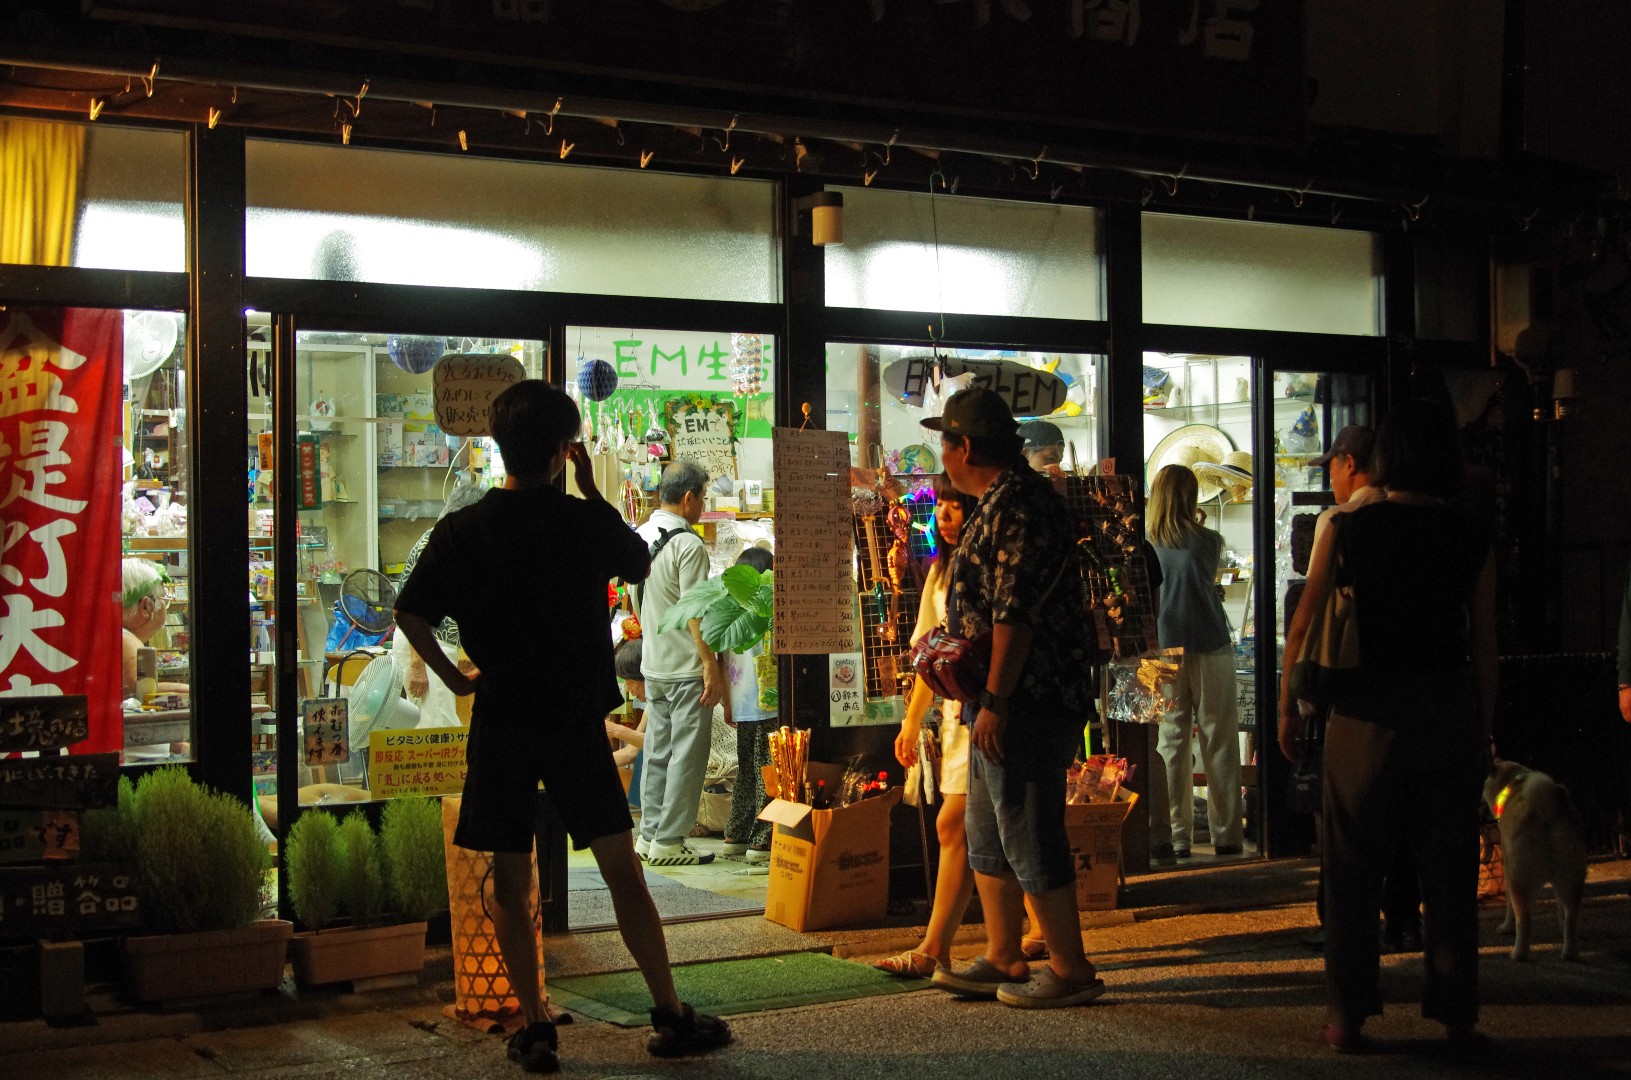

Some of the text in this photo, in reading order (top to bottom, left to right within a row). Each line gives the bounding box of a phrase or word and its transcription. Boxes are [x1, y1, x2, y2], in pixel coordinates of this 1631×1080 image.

[613, 340, 772, 382] EM生
[684, 418, 721, 433] EMで
[308, 707, 327, 762] 使えます
[330, 704, 345, 756] おむつ券
[375, 750, 403, 763] 即反応
[0, 876, 138, 920] ・贈答品
